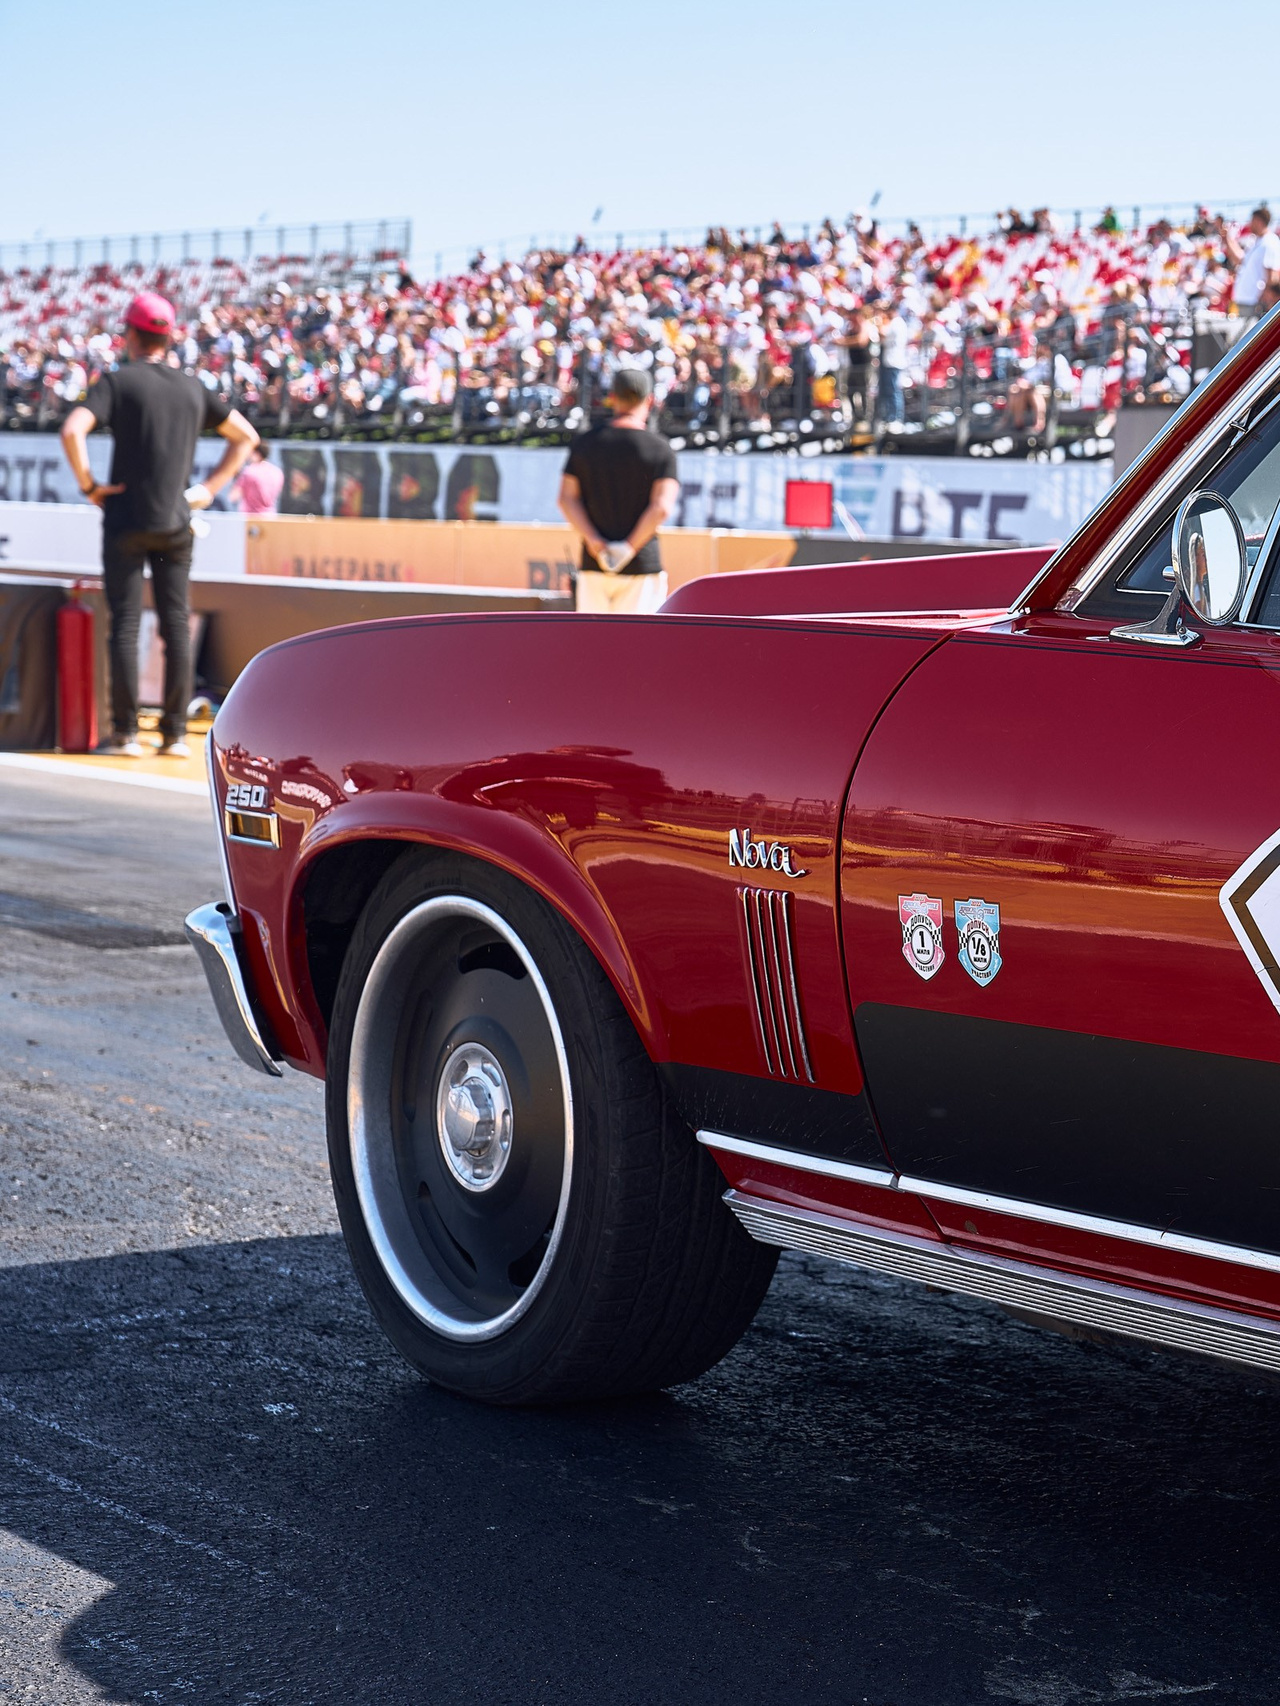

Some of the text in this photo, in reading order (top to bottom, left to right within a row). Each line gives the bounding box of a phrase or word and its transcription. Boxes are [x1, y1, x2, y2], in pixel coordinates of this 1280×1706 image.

[226, 783, 266, 808] 250
[728, 828, 811, 878] Nova
[910, 914, 933, 930] ДОПУСК
[966, 919, 990, 935] ДОПУСК
[918, 931, 925, 947] 1
[972, 937, 987, 957] 1/8
